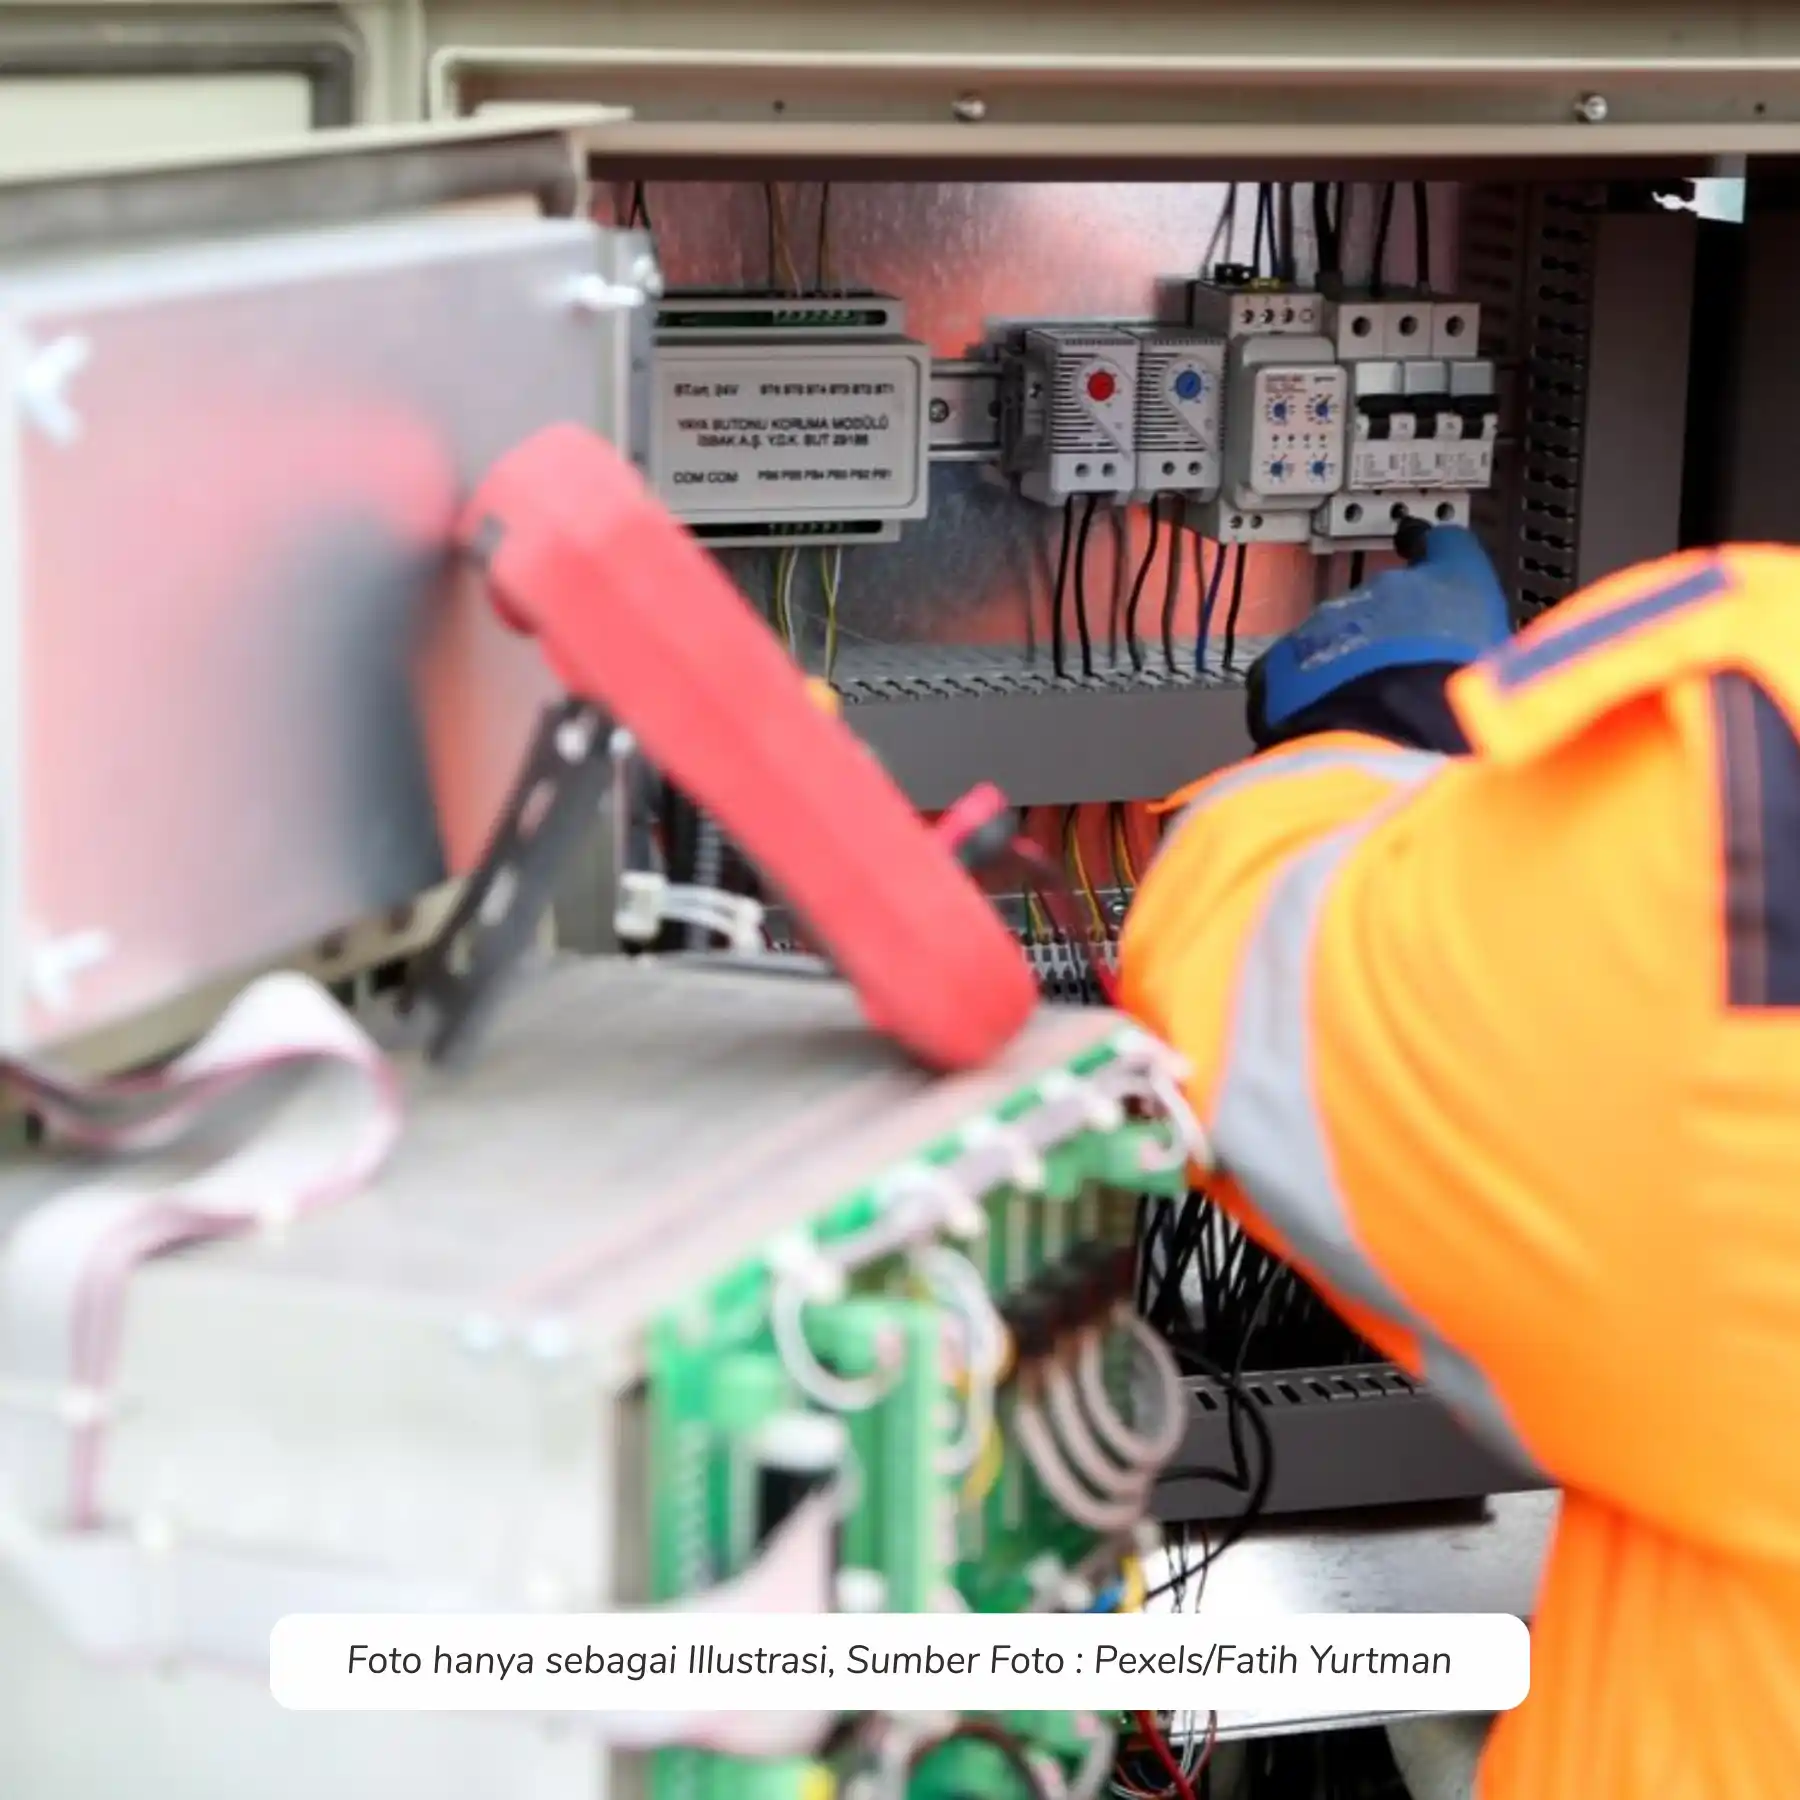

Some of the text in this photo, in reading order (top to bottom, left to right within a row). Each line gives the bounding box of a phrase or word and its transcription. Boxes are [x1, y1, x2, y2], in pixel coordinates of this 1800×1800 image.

[712, 418, 768, 431] BUTONU
[771, 417, 829, 431] KORUMA
[832, 414, 889, 431] MODÜLÜ
[673, 471, 738, 484] COM COM
